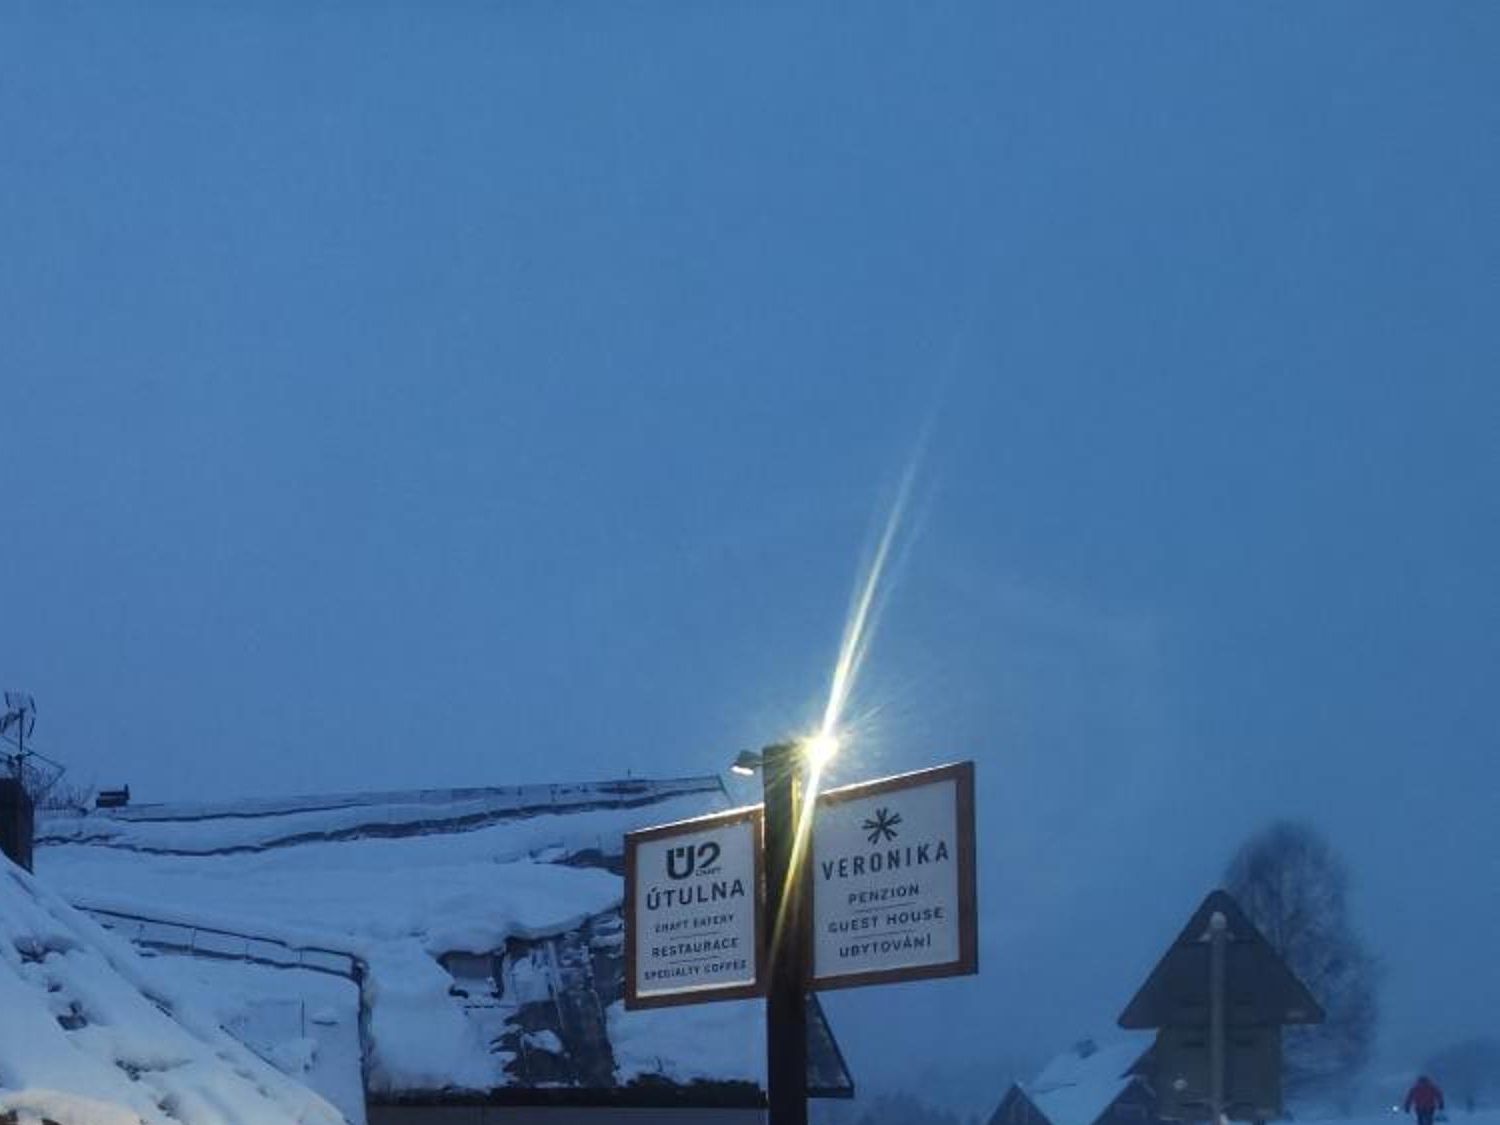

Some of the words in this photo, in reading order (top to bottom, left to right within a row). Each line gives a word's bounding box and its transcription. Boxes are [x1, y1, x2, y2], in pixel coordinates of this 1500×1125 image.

[822, 841, 949, 881] VERONIKA
[647, 879, 745, 911] ÚTULNA
[848, 884, 920, 905] PENZION
[828, 915, 879, 934] GUEST
[886, 907, 945, 925] HOUSE
[651, 937, 739, 957] RESTAURACE
[644, 966, 699, 980] SPECIALTY
[703, 959, 747, 973] COFFEE
